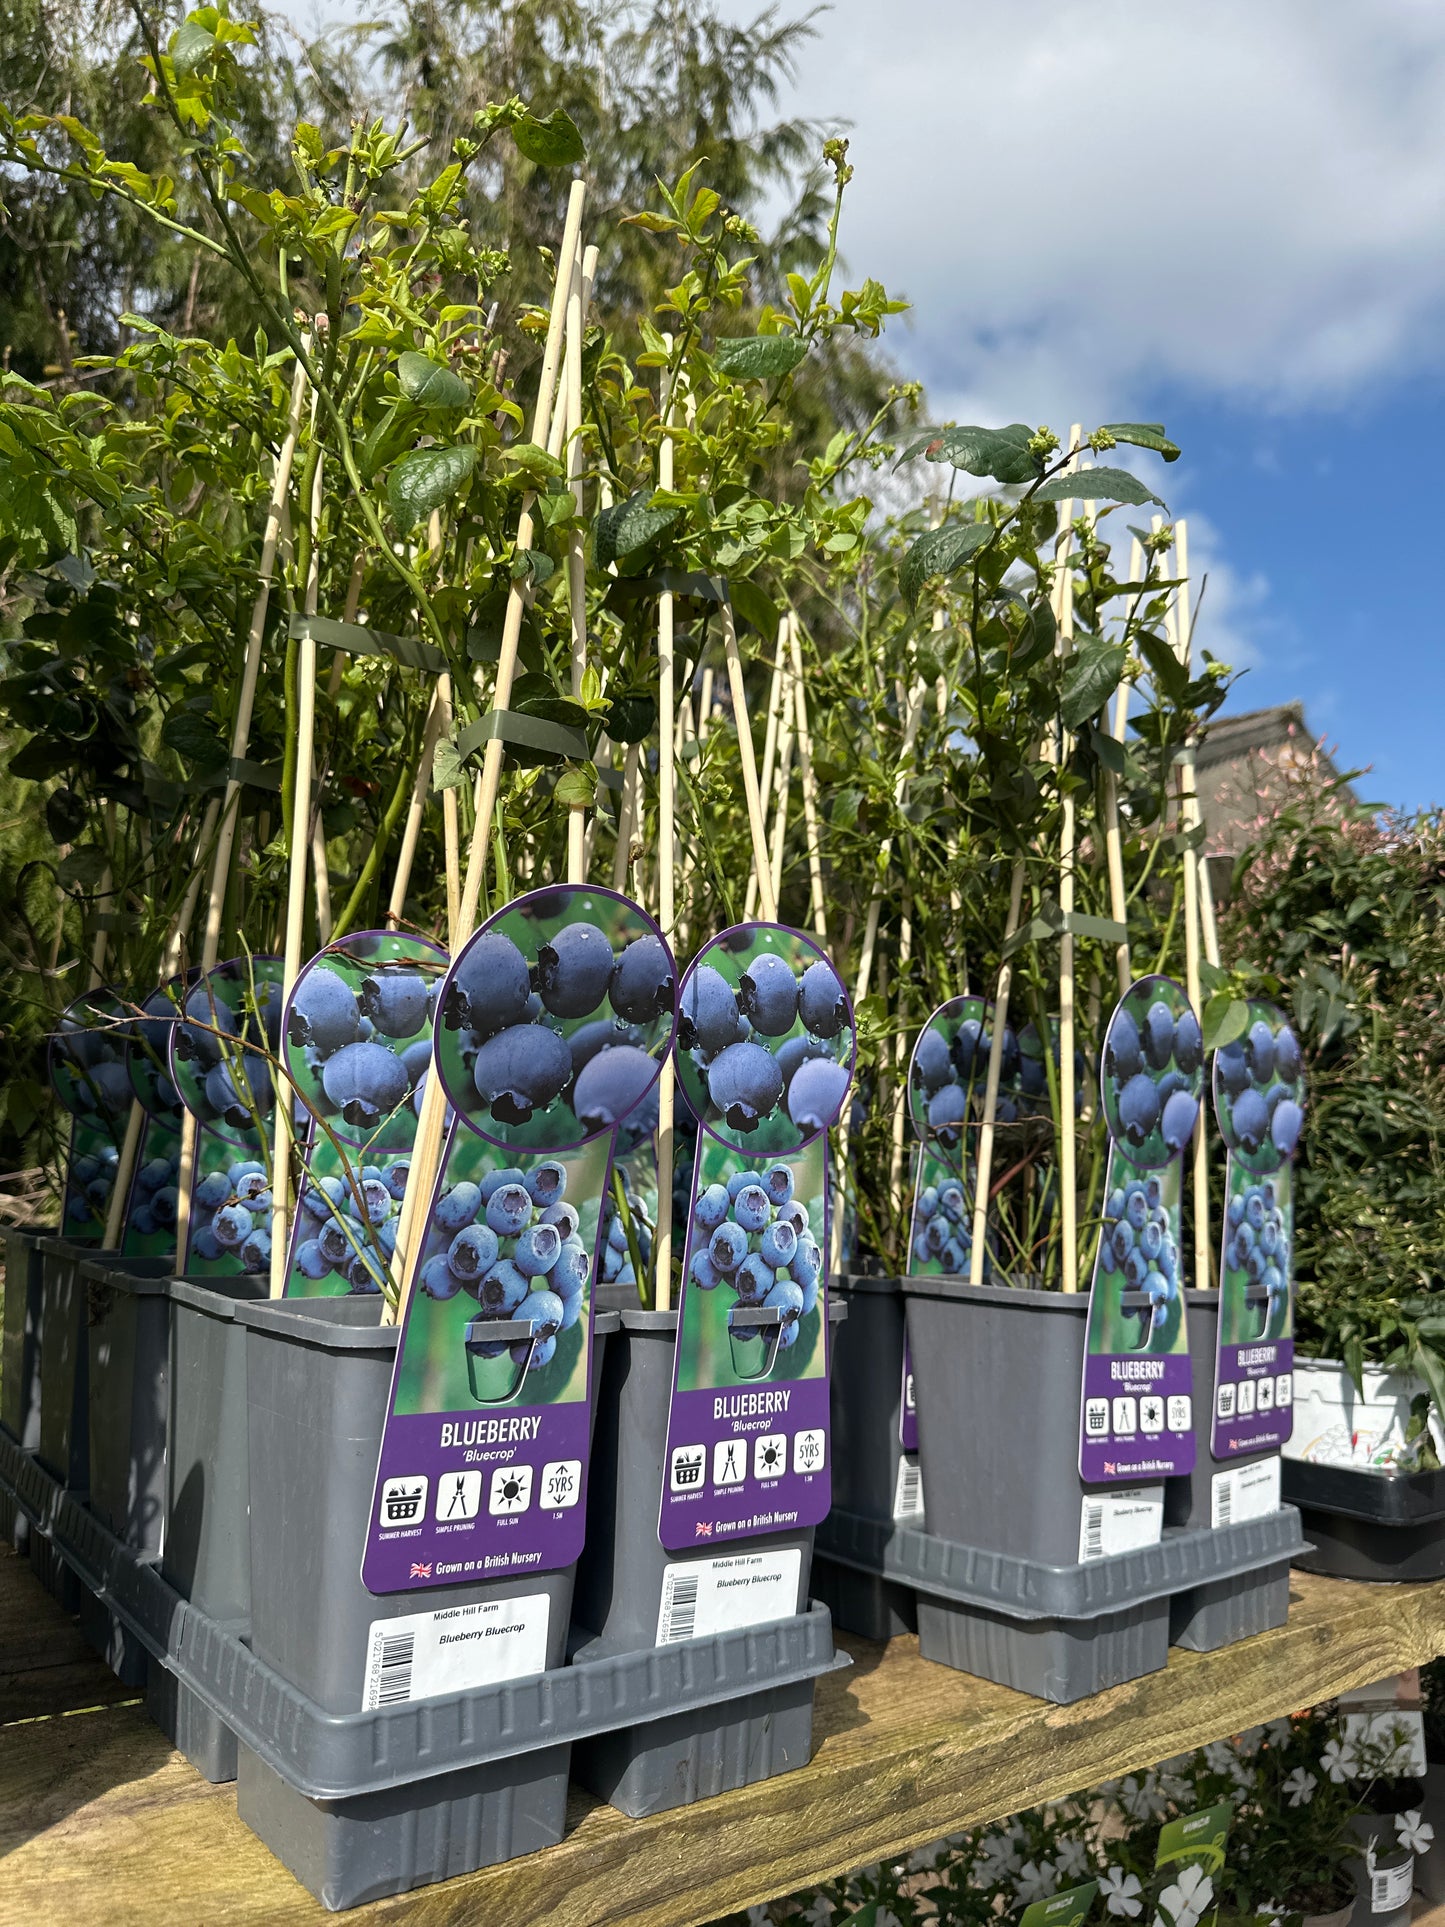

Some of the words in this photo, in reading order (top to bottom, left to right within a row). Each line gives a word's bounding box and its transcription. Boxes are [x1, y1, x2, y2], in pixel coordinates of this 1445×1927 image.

[1111, 1361, 1165, 1380] BLUEBERRY
[713, 1390, 791, 1419] BLUEBERRY
[440, 1416, 542, 1447] BLUEBERRY
[731, 1417, 773, 1432] 'Bluecrop'
[463, 1447, 517, 1463] 'Bluecrop'
[800, 1443, 819, 1459] 5YRS
[548, 1475, 574, 1493] 5YRS
[435, 1525, 453, 1534] SIMPLE
[453, 1522, 475, 1532] PRUNING
[497, 1518, 508, 1526] FULL
[715, 1521, 736, 1533] Grown
[737, 1520, 746, 1528] on
[747, 1519, 752, 1527] a
[753, 1512, 772, 1526] British
[774, 1510, 798, 1523] Nursery
[401, 1528, 422, 1537] HARVEST
[436, 1561, 462, 1575] Grown
[464, 1561, 474, 1570] on
[476, 1559, 482, 1568] a
[484, 1553, 510, 1568] British
[511, 1551, 542, 1565] Nursery
[712, 1560, 734, 1569] Middle
[735, 1558, 746, 1566] Hill
[747, 1556, 762, 1564] Farm
[717, 1577, 750, 1589] Blueberry
[752, 1572, 782, 1584] Bluecrop
[433, 1609, 460, 1621] Middle
[462, 1606, 476, 1617] Hill
[478, 1603, 499, 1614] Farm
[439, 1629, 484, 1645] Blueberry
[485, 1622, 525, 1637] Bluecrop
